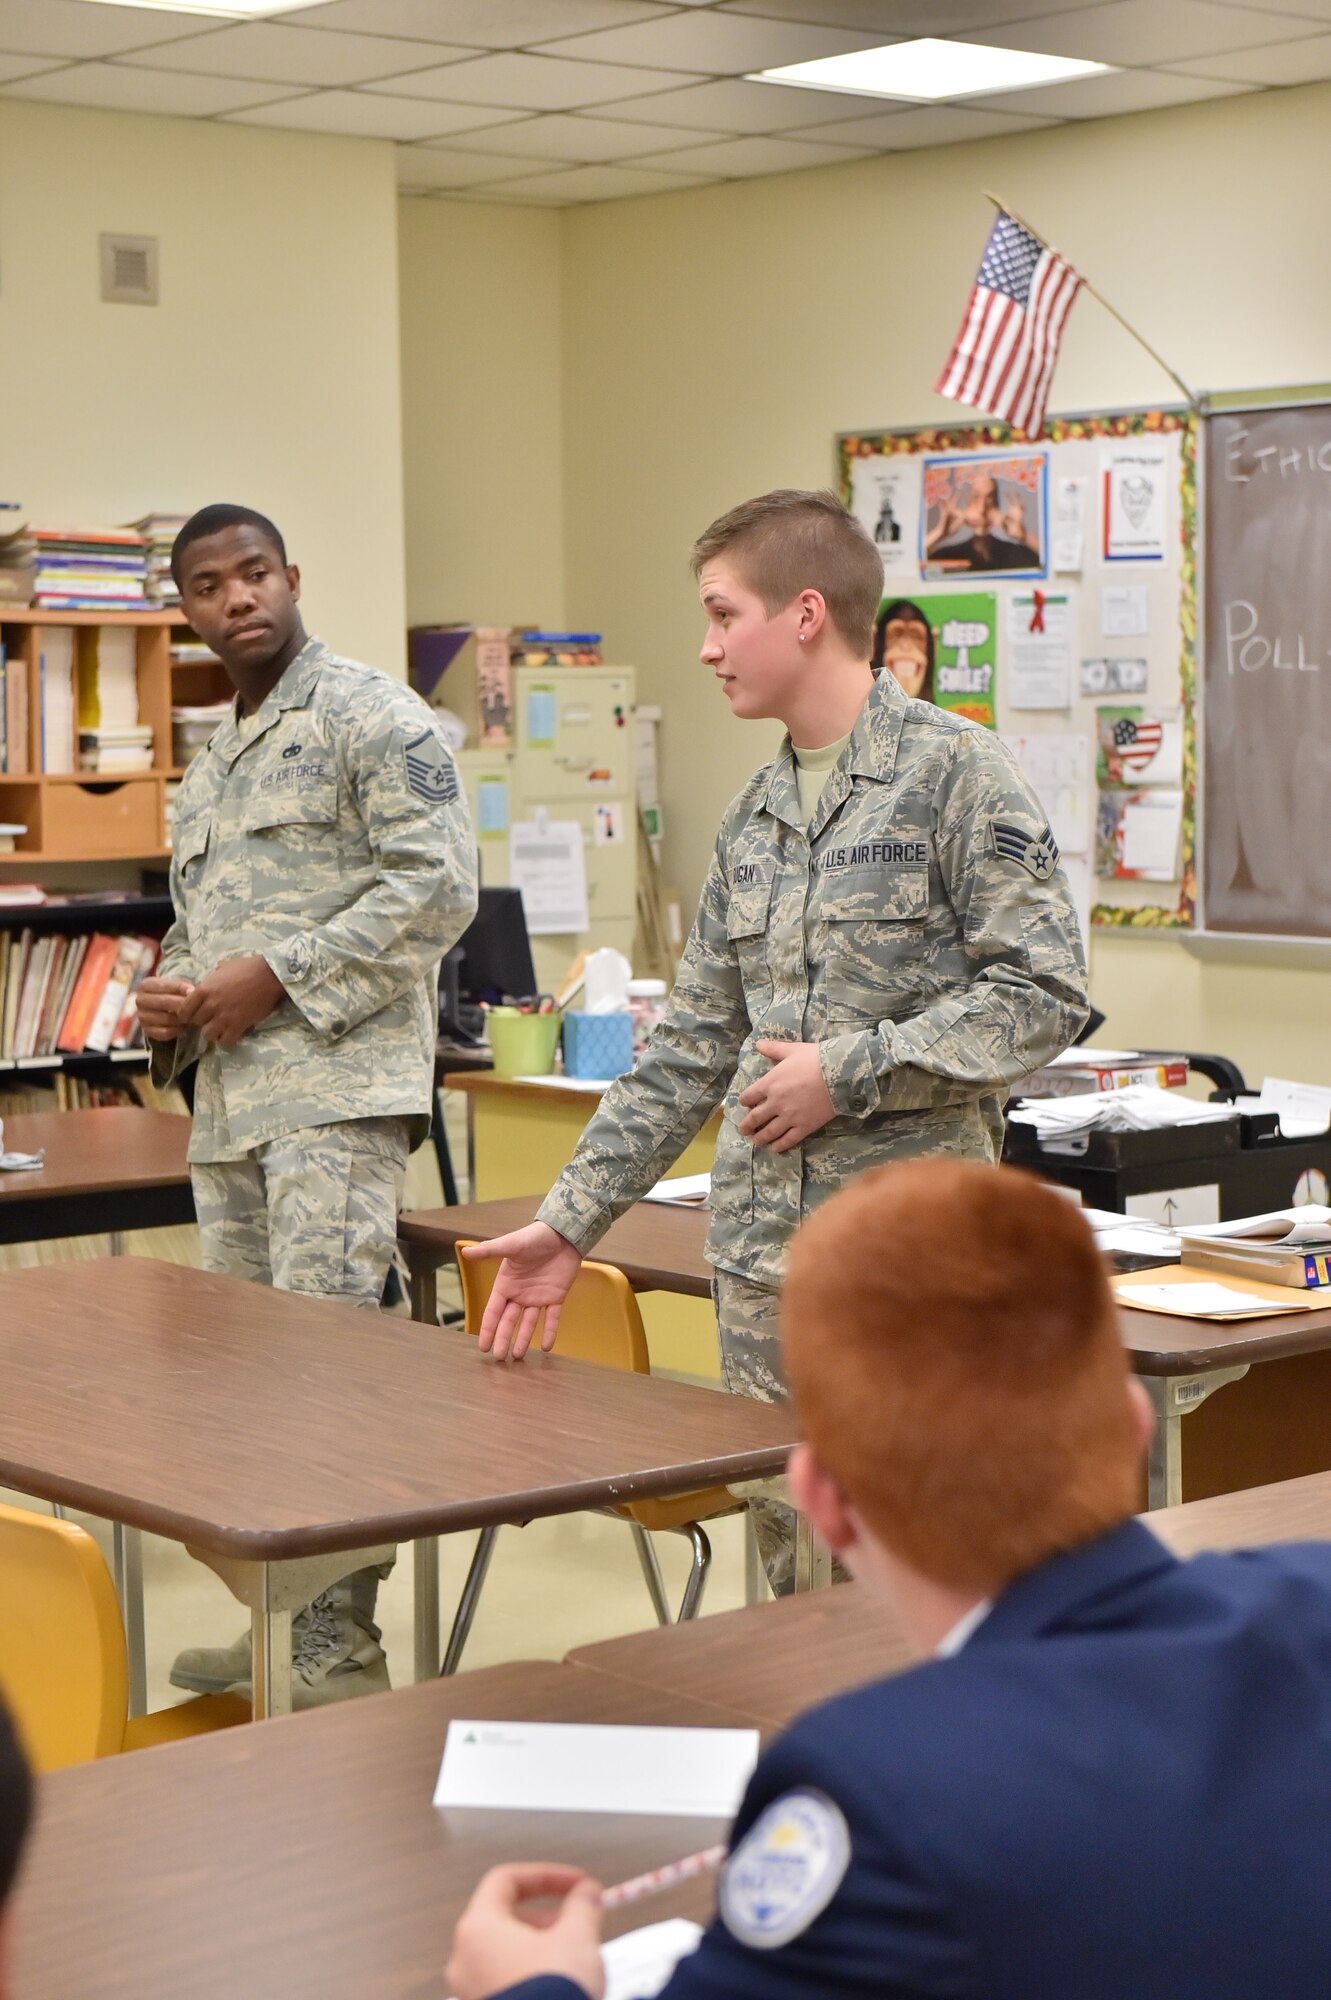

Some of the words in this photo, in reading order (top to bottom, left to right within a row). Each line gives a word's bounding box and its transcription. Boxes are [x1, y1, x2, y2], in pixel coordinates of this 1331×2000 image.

[276, 768, 290, 784] AIR
[291, 764, 326, 779] FORCE
[826, 849, 847, 867] U.S.
[850, 845, 869, 864] AIR
[872, 844, 926, 862] FORCE
